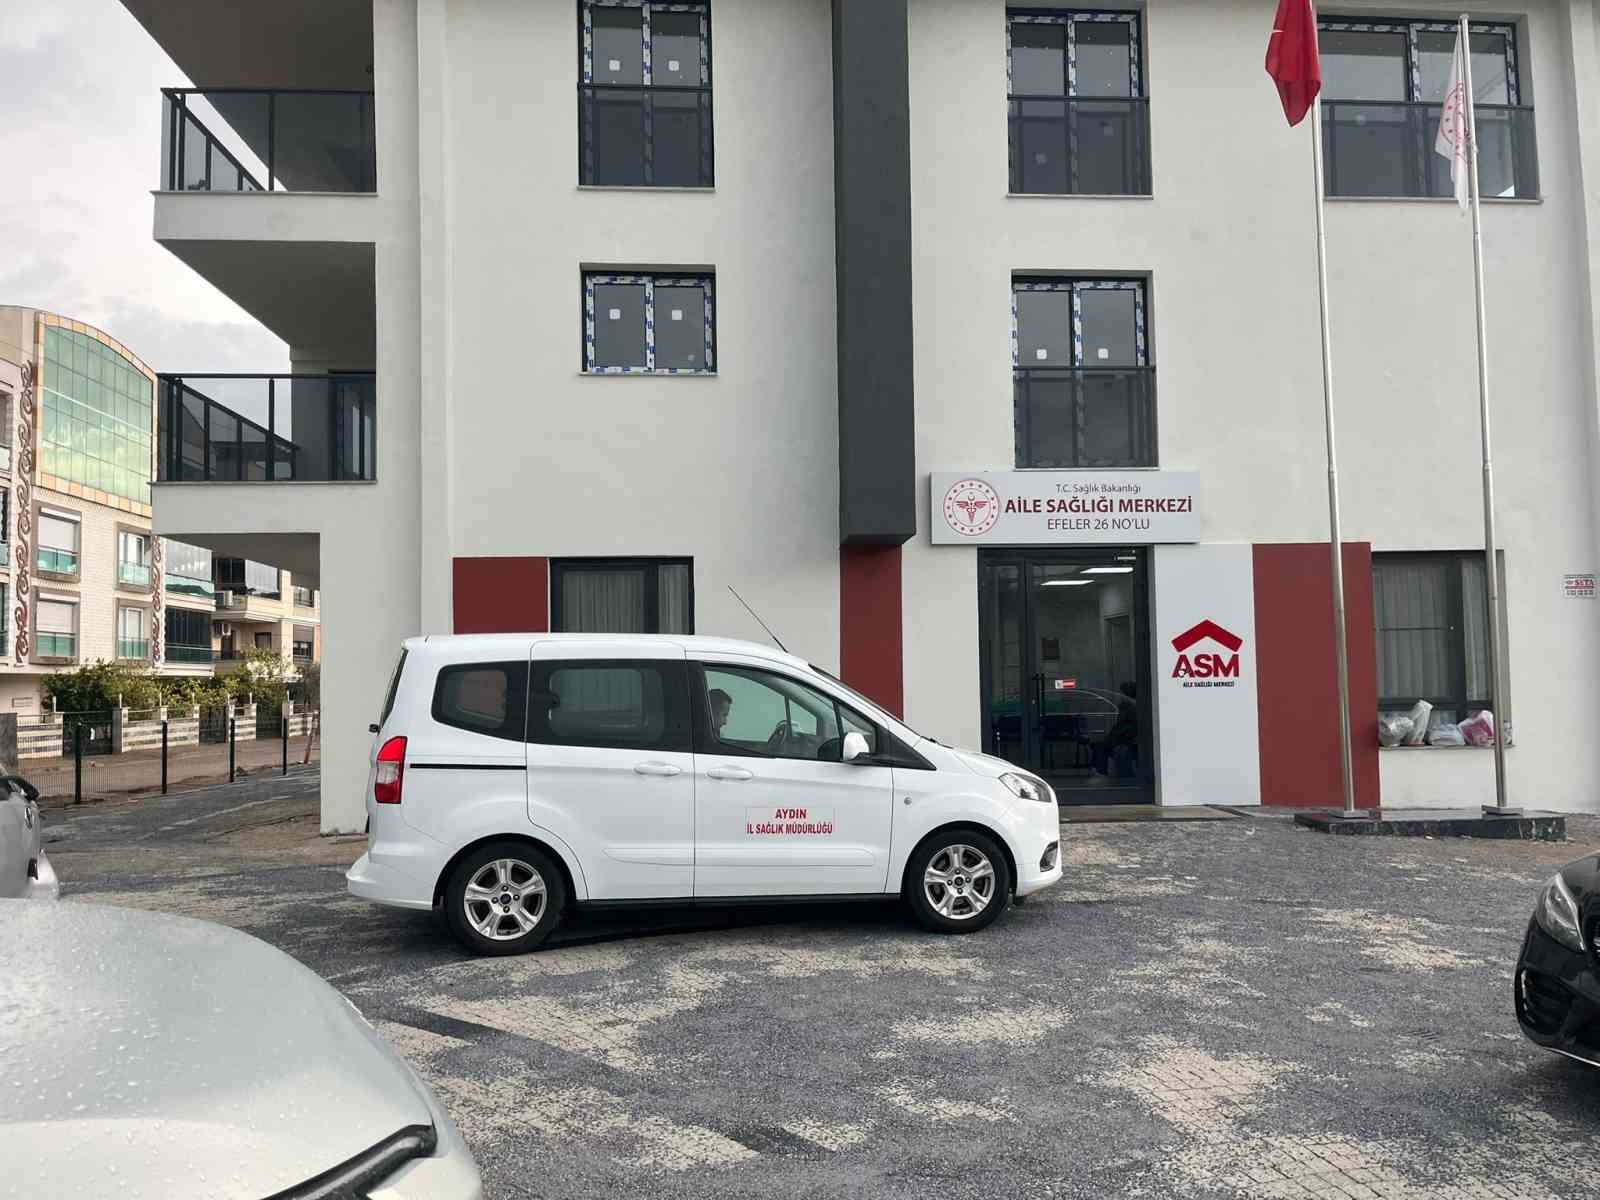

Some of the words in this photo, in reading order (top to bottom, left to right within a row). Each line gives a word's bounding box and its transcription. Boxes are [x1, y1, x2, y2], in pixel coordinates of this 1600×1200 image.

[1056, 483, 1072, 493] T.C.
[1073, 483, 1100, 495] Sağlık
[1101, 483, 1141, 495] Bakanlığı
[1005, 496, 1042, 513] AİLE
[1046, 496, 1114, 513] SAĞLIĞI
[1119, 496, 1192, 513] MERKEZİ
[1047, 518, 1090, 530] EFELER
[1094, 518, 1109, 530] 26
[1172, 654, 1239, 678] ASM
[775, 808, 807, 819] AYDIN
[746, 821, 754, 834] İL
[755, 821, 784, 834] SAĞLIK
[786, 821, 833, 834] MÜDÜRLÜĞÜ
